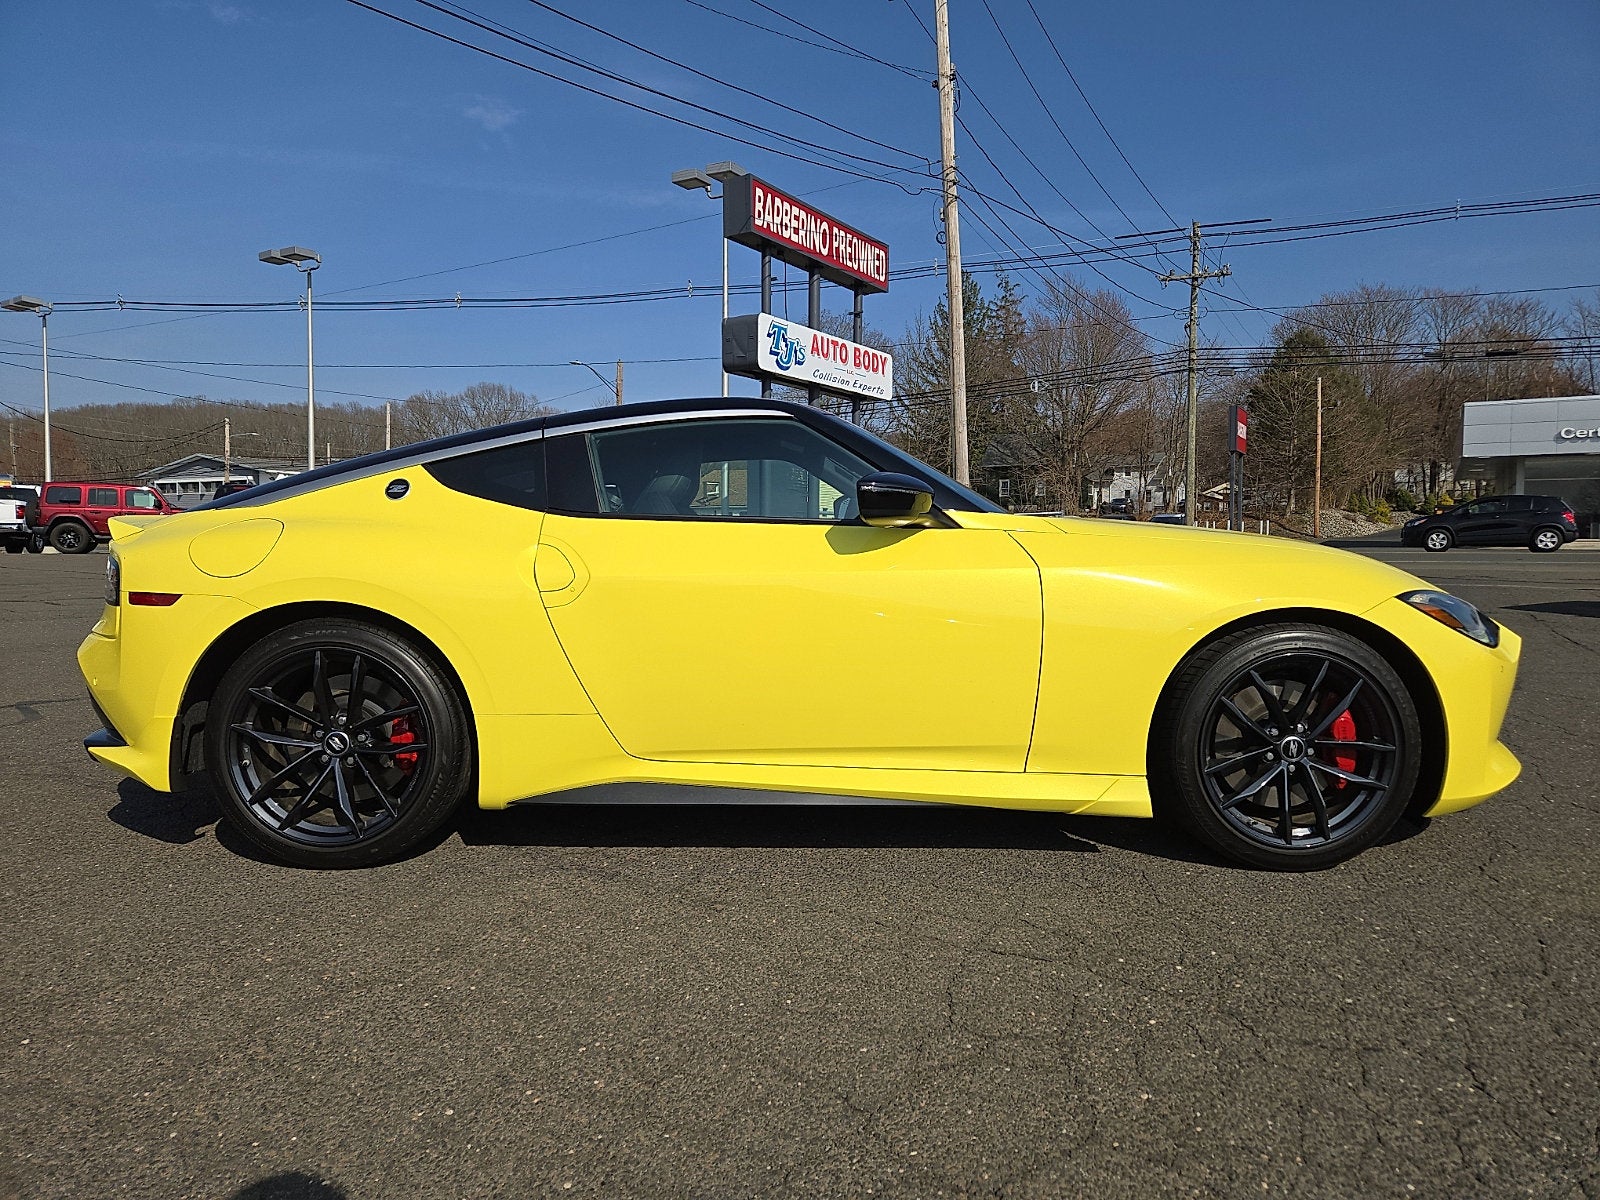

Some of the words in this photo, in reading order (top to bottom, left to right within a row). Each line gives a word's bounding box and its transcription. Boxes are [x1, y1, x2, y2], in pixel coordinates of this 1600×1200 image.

[754, 186, 830, 257] BARBERINO
[832, 226, 886, 282] PREOWNED
[811, 333, 849, 365] AUTO
[853, 346, 888, 377] BODY
[812, 368, 850, 386] Collision
[852, 379, 885, 395] Experts
